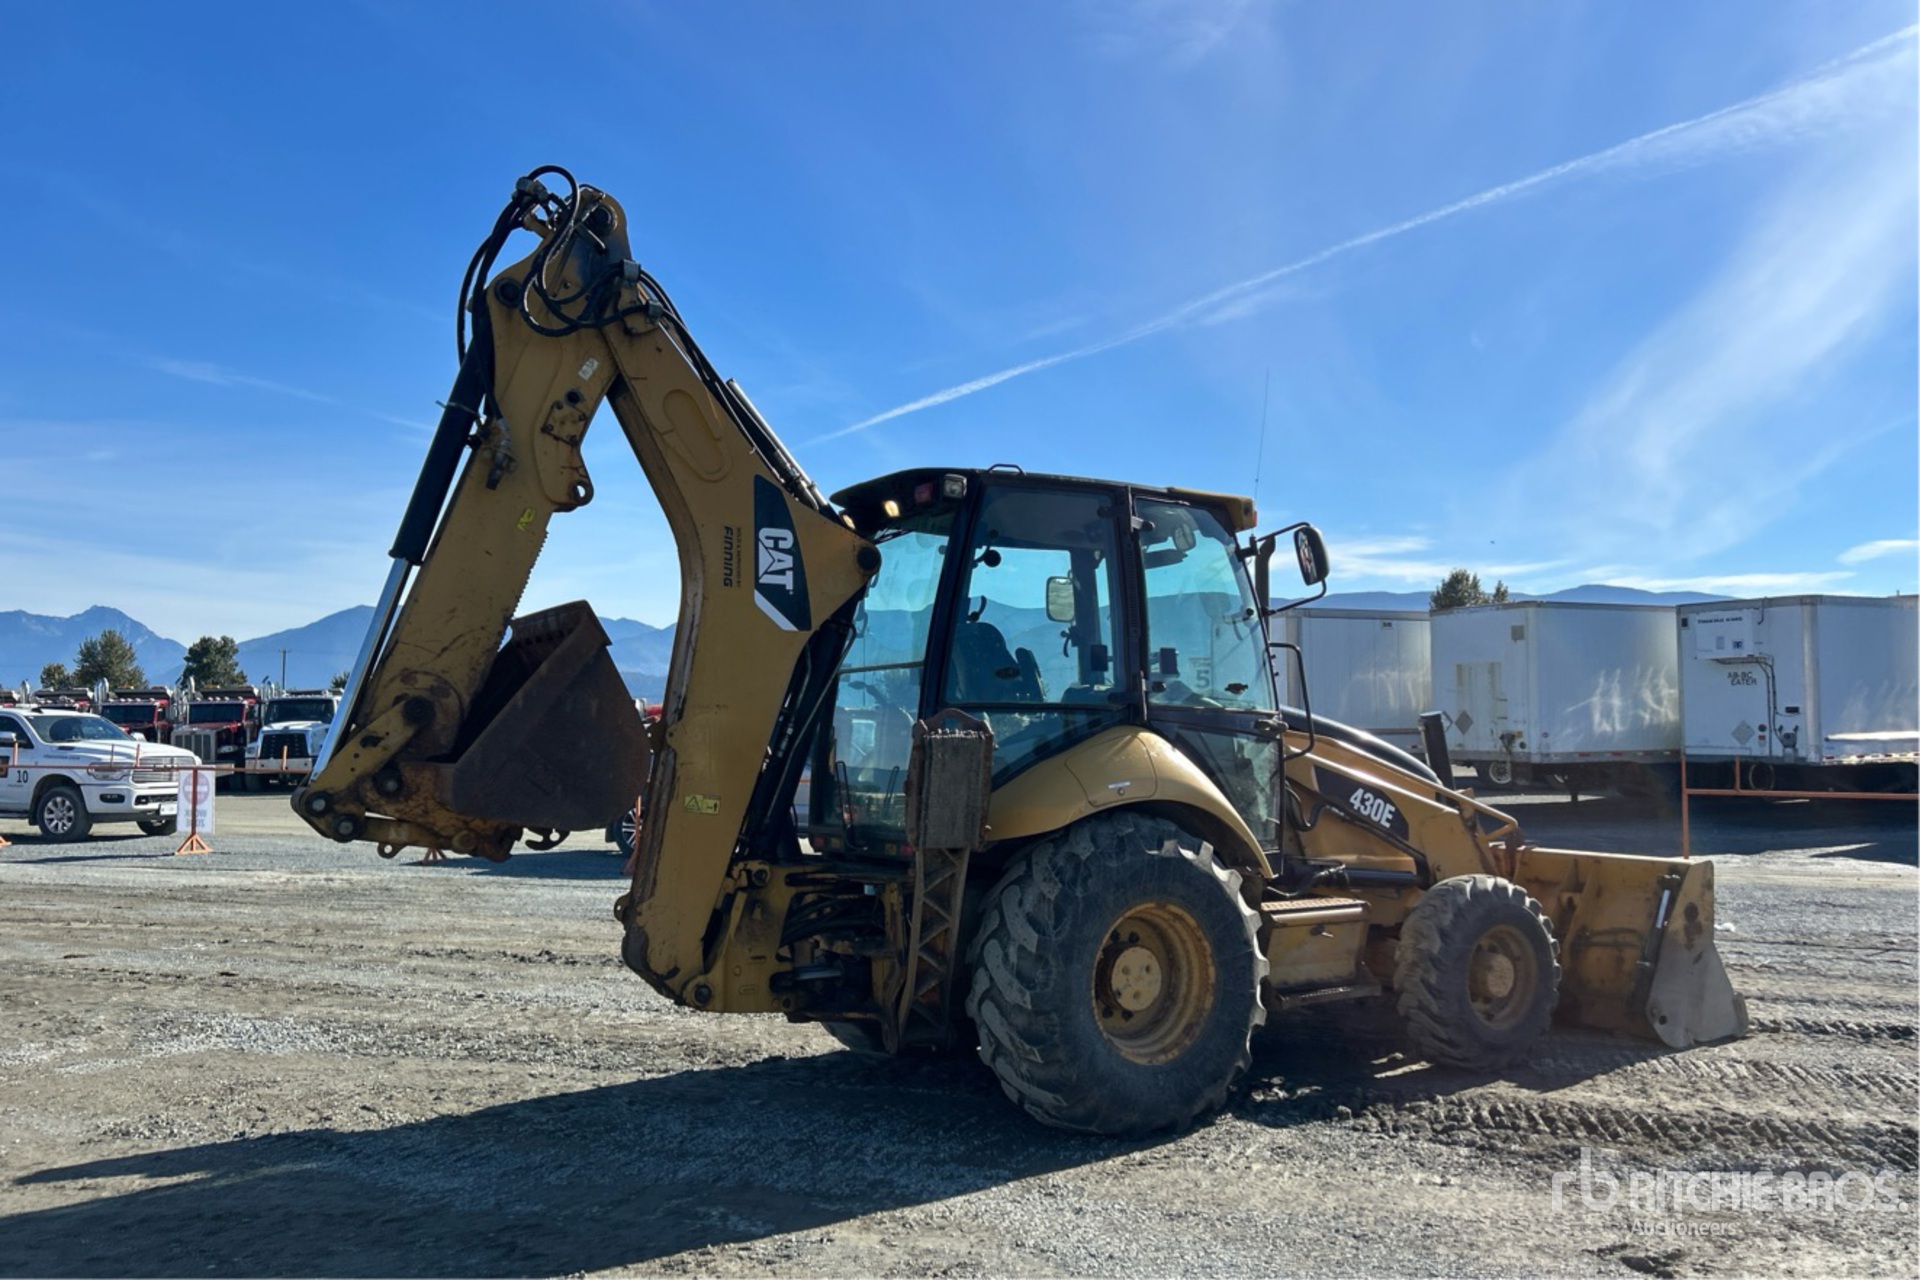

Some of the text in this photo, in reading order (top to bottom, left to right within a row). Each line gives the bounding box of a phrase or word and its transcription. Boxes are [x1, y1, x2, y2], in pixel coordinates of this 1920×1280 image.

[724, 526, 734, 588] FINNING
[759, 527, 794, 590] CAT
[16, 769, 29, 784] 10
[1349, 787, 1396, 829] 430E
